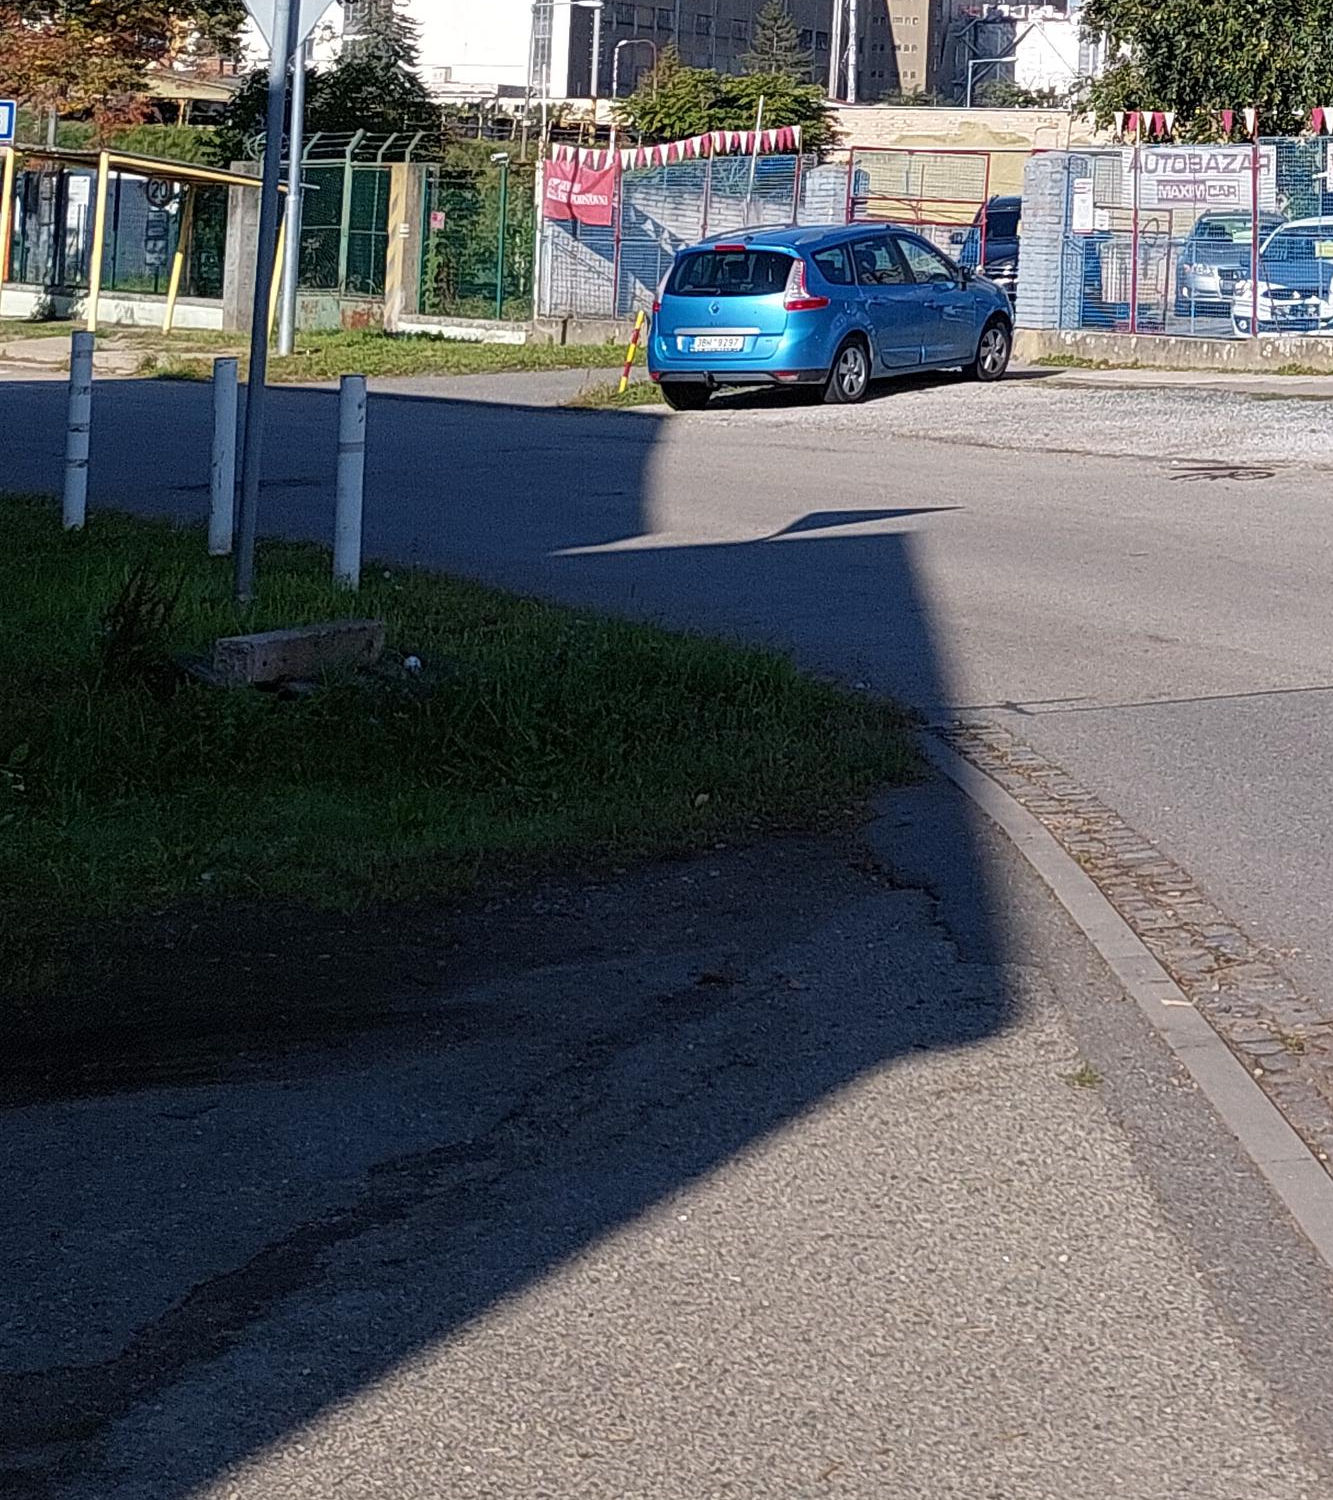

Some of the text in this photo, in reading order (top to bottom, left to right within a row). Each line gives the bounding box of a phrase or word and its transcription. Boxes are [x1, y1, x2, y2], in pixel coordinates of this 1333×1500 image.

[151, 181, 168, 199] 20
[1160, 183, 1237, 199] MAXIM CAR
